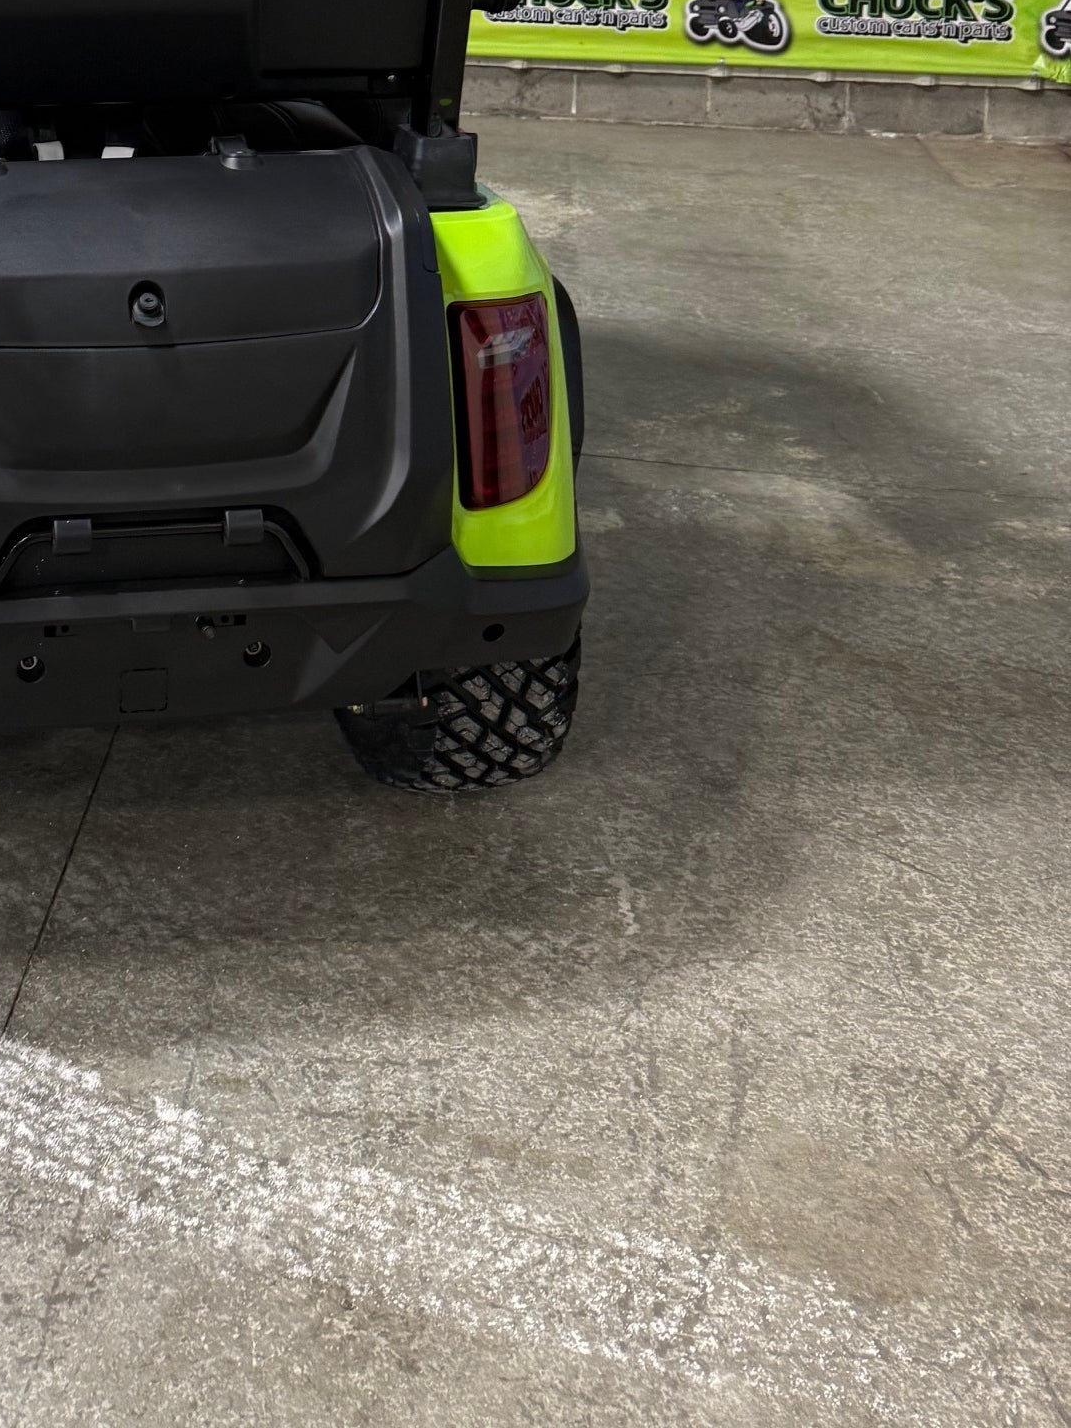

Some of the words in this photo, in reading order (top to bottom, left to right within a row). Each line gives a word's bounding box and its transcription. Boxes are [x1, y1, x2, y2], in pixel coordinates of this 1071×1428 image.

[618, 10, 667, 31] parts
[817, 17, 891, 36] custom
[959, 20, 1013, 43] parts
